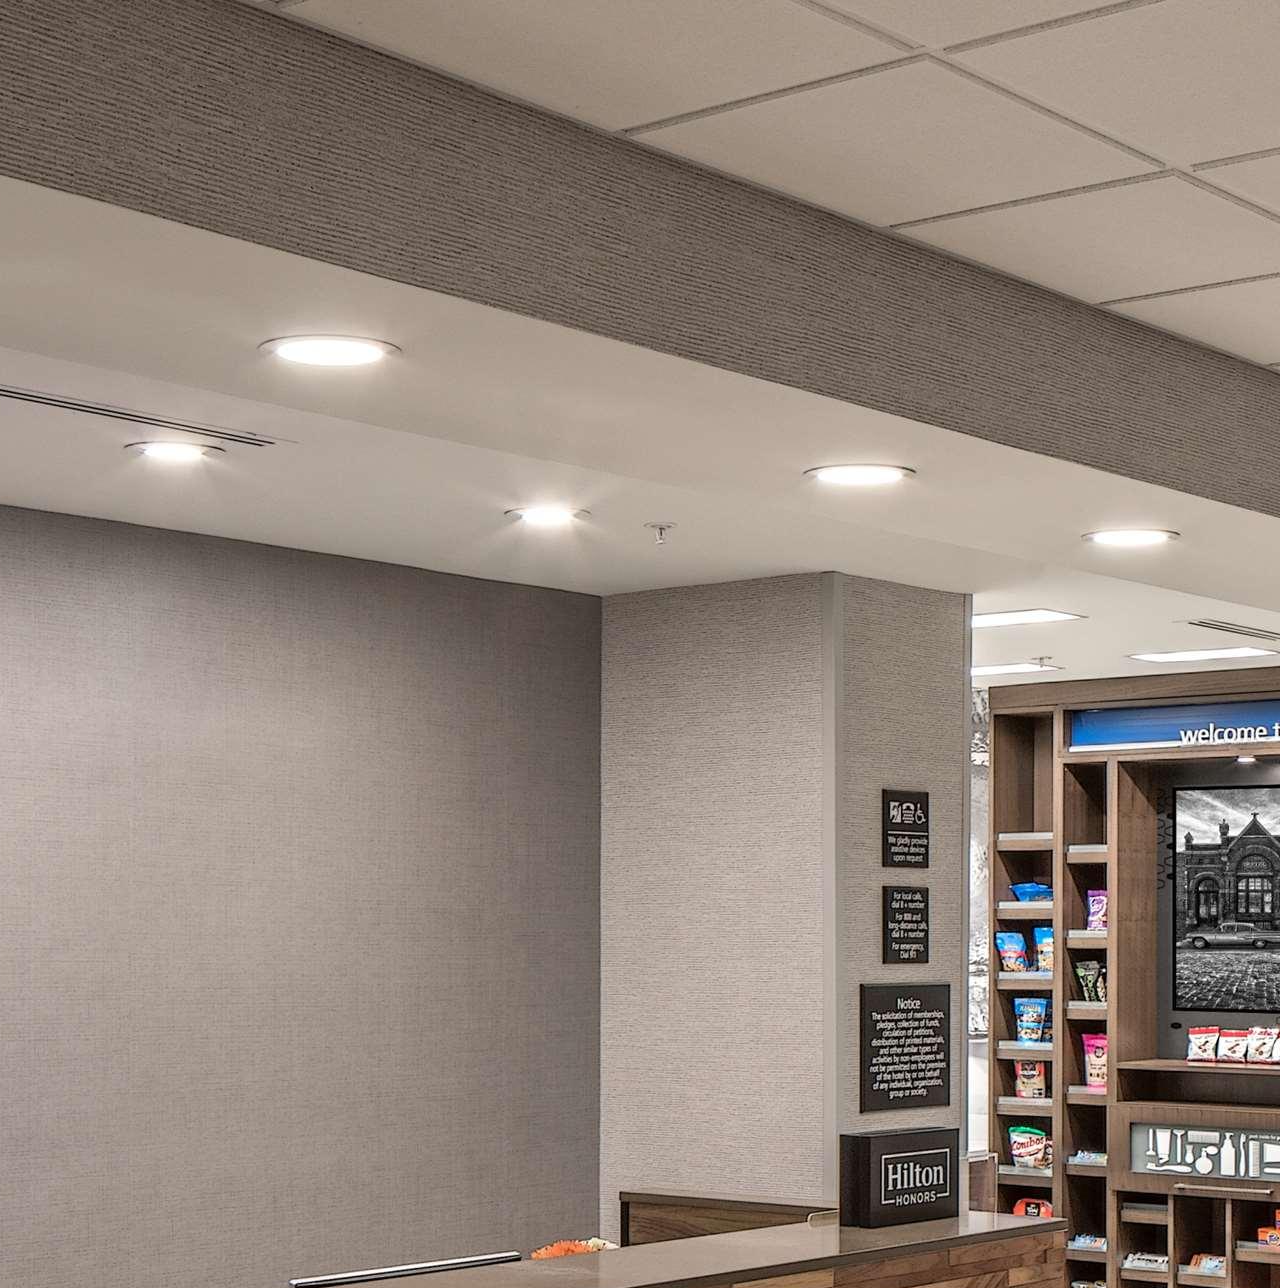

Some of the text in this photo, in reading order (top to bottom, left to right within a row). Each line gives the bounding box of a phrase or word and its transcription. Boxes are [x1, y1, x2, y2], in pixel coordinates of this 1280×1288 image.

[1180, 722, 1266, 742] welcome
[897, 997, 920, 1010] Notice
[872, 1012, 881, 1020] The
[882, 1011, 906, 1020] solicitation
[882, 1029, 906, 1037] circulation
[871, 1038, 898, 1047] distribution
[890, 1046, 902, 1054] other
[918, 1045, 931, 1055] types
[872, 1055, 892, 1064] activities
[870, 1065, 878, 1073] not
[886, 1063, 910, 1072] permitted
[883, 1072, 892, 1080] the
[892, 1072, 904, 1080] hotel
[880, 1082, 888, 1091] any
[889, 1090, 904, 1100] group
[1012, 1136, 1044, 1151] Combos
[888, 1162, 944, 1191] Hilton
[896, 1190, 936, 1206] HONORS
